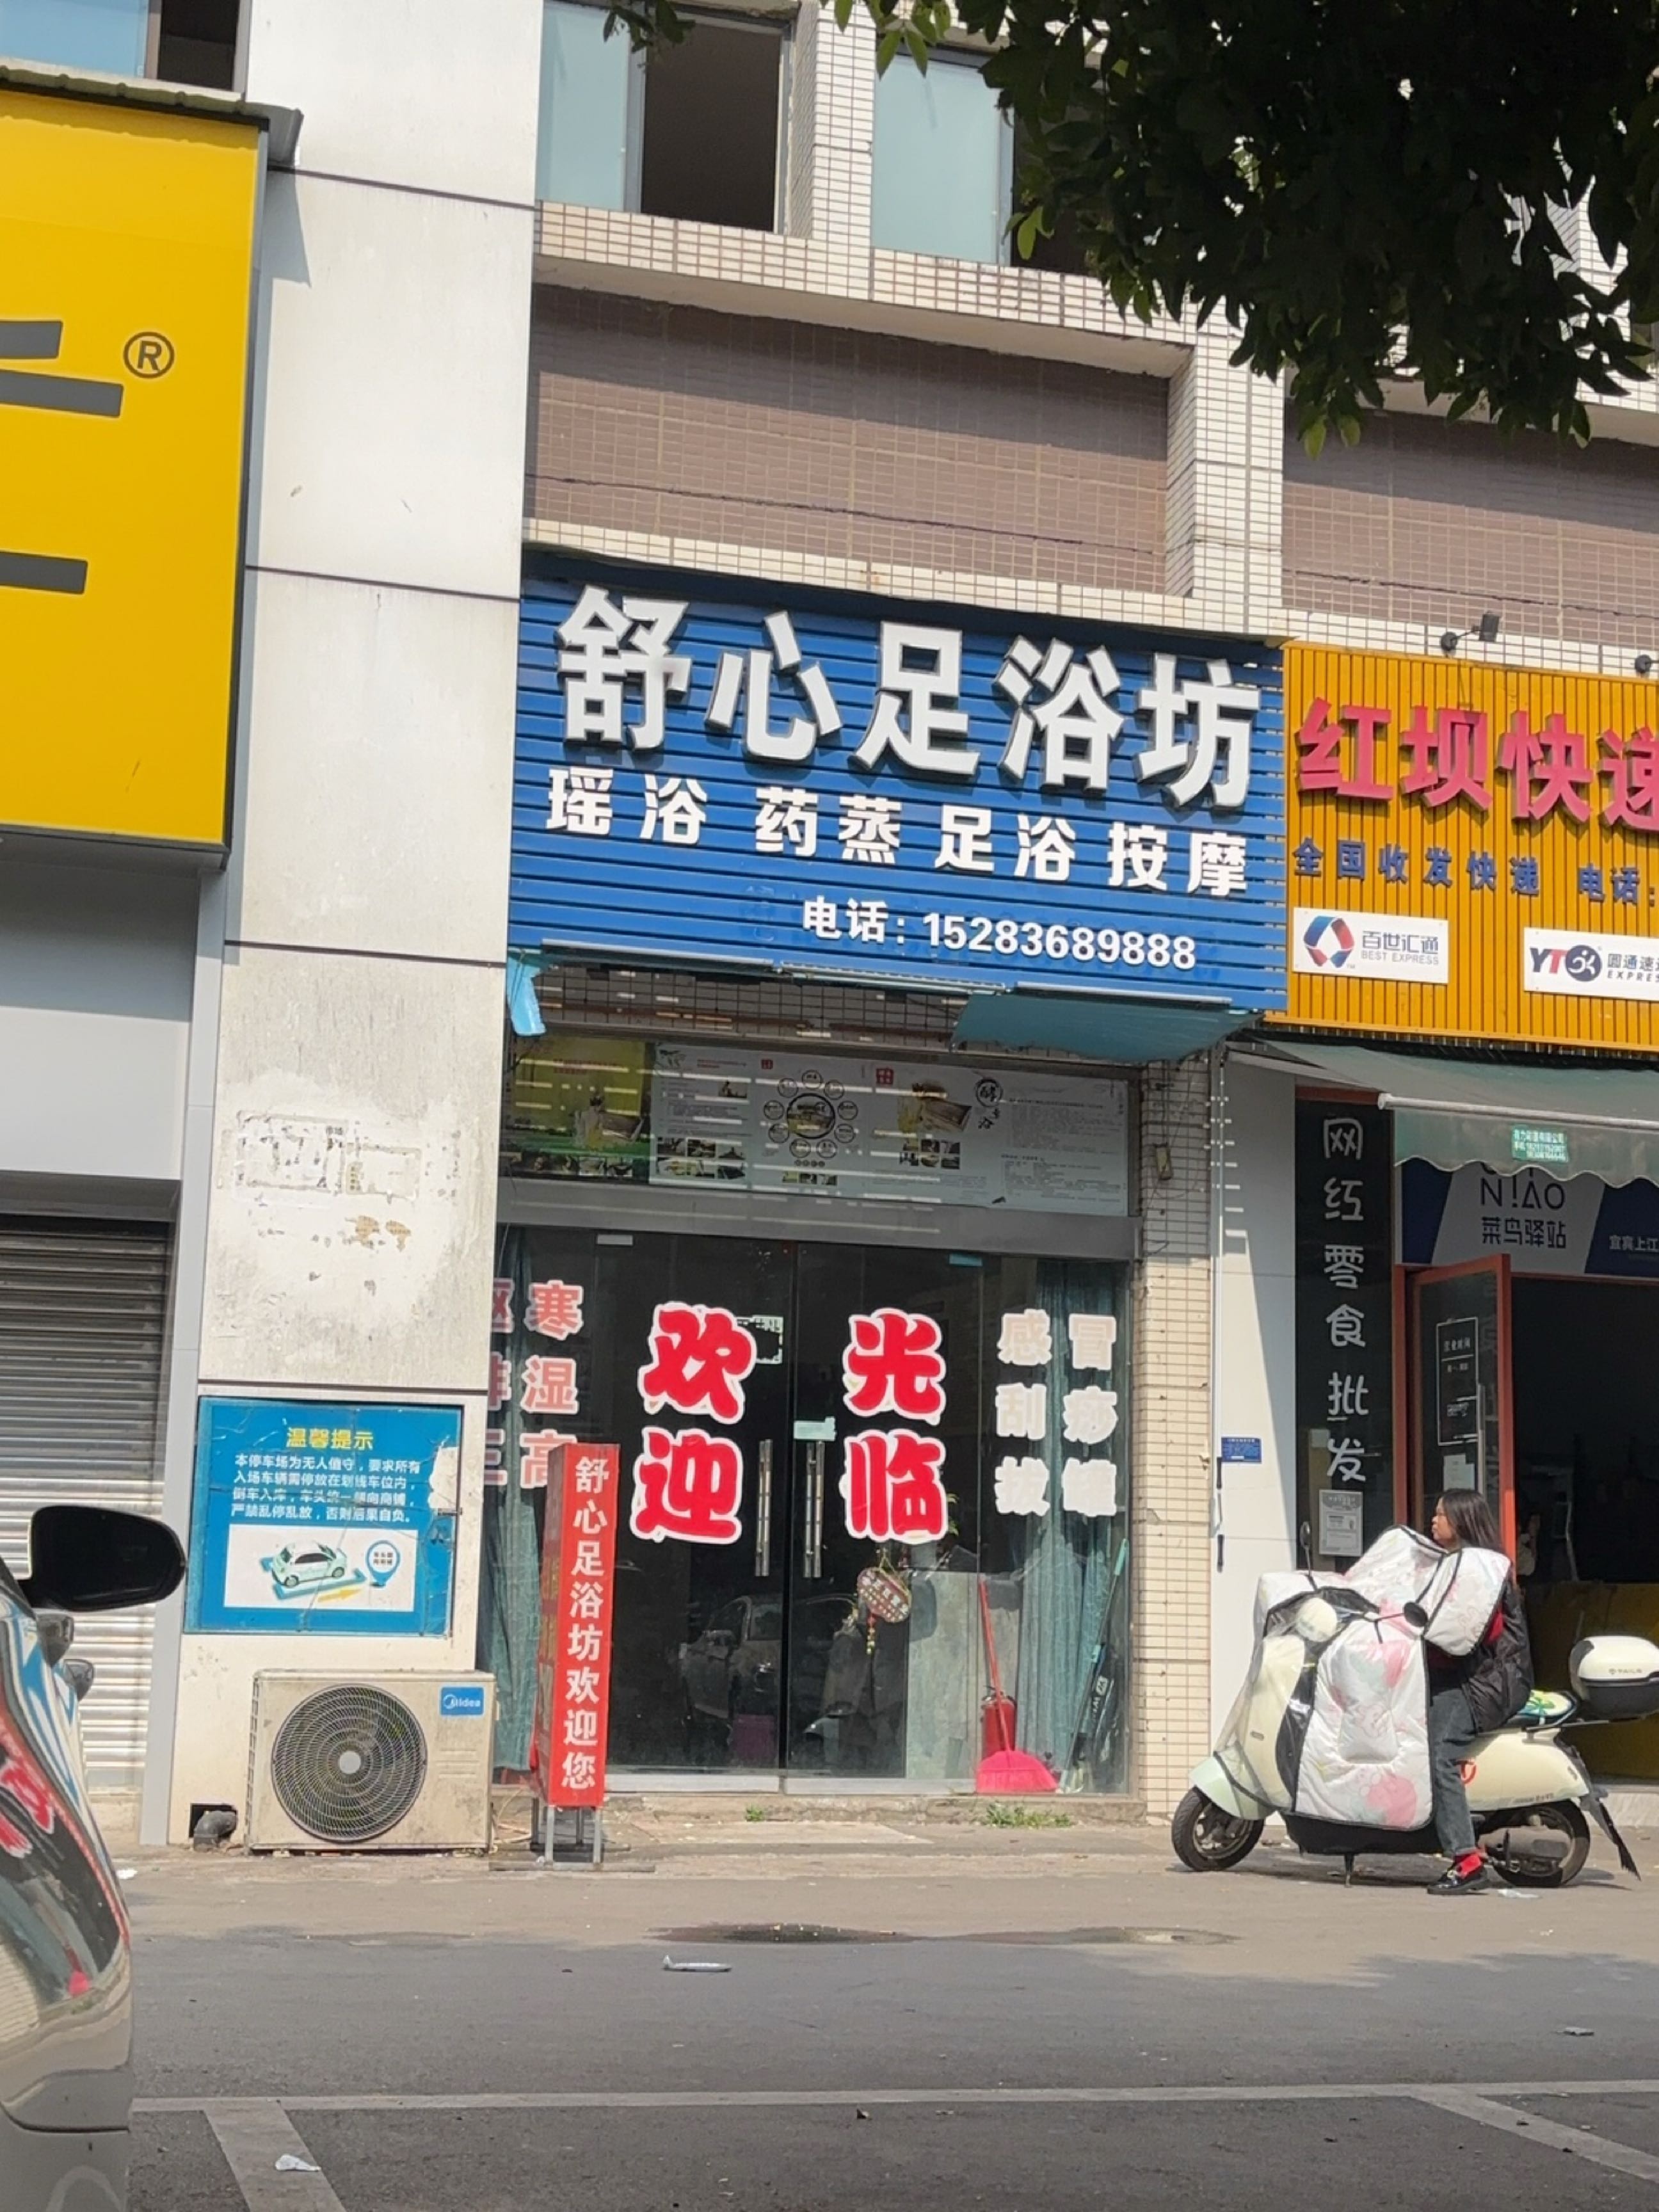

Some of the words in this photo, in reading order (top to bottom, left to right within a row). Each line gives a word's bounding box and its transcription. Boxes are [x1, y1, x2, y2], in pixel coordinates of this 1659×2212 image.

[555, 586, 1261, 808] 舒心足浴坊
[1294, 697, 1659, 832] 红坝快递
[546, 766, 708, 846] 瑶浴
[755, 788, 902, 862] 药蒸
[933, 805, 1077, 881] 足浴
[1107, 822, 1249, 897] 按摩
[1293, 837, 1539, 897] 全国收发快递
[1361, 931, 1439, 954] 百世汇通
[1361, 950, 1388, 961] BEST
[1392, 952, 1439, 965] EXPRESS
[1607, 954, 1659, 972] 圆通速
[1482, 1217, 1567, 1249] 菜鸟驿站
[1323, 1118, 1368, 1482] 网红零食批发
[286, 1427, 374, 1451] 温馨提示
[561, 1456, 610, 1790] 舒心足浴坊欢迎您
